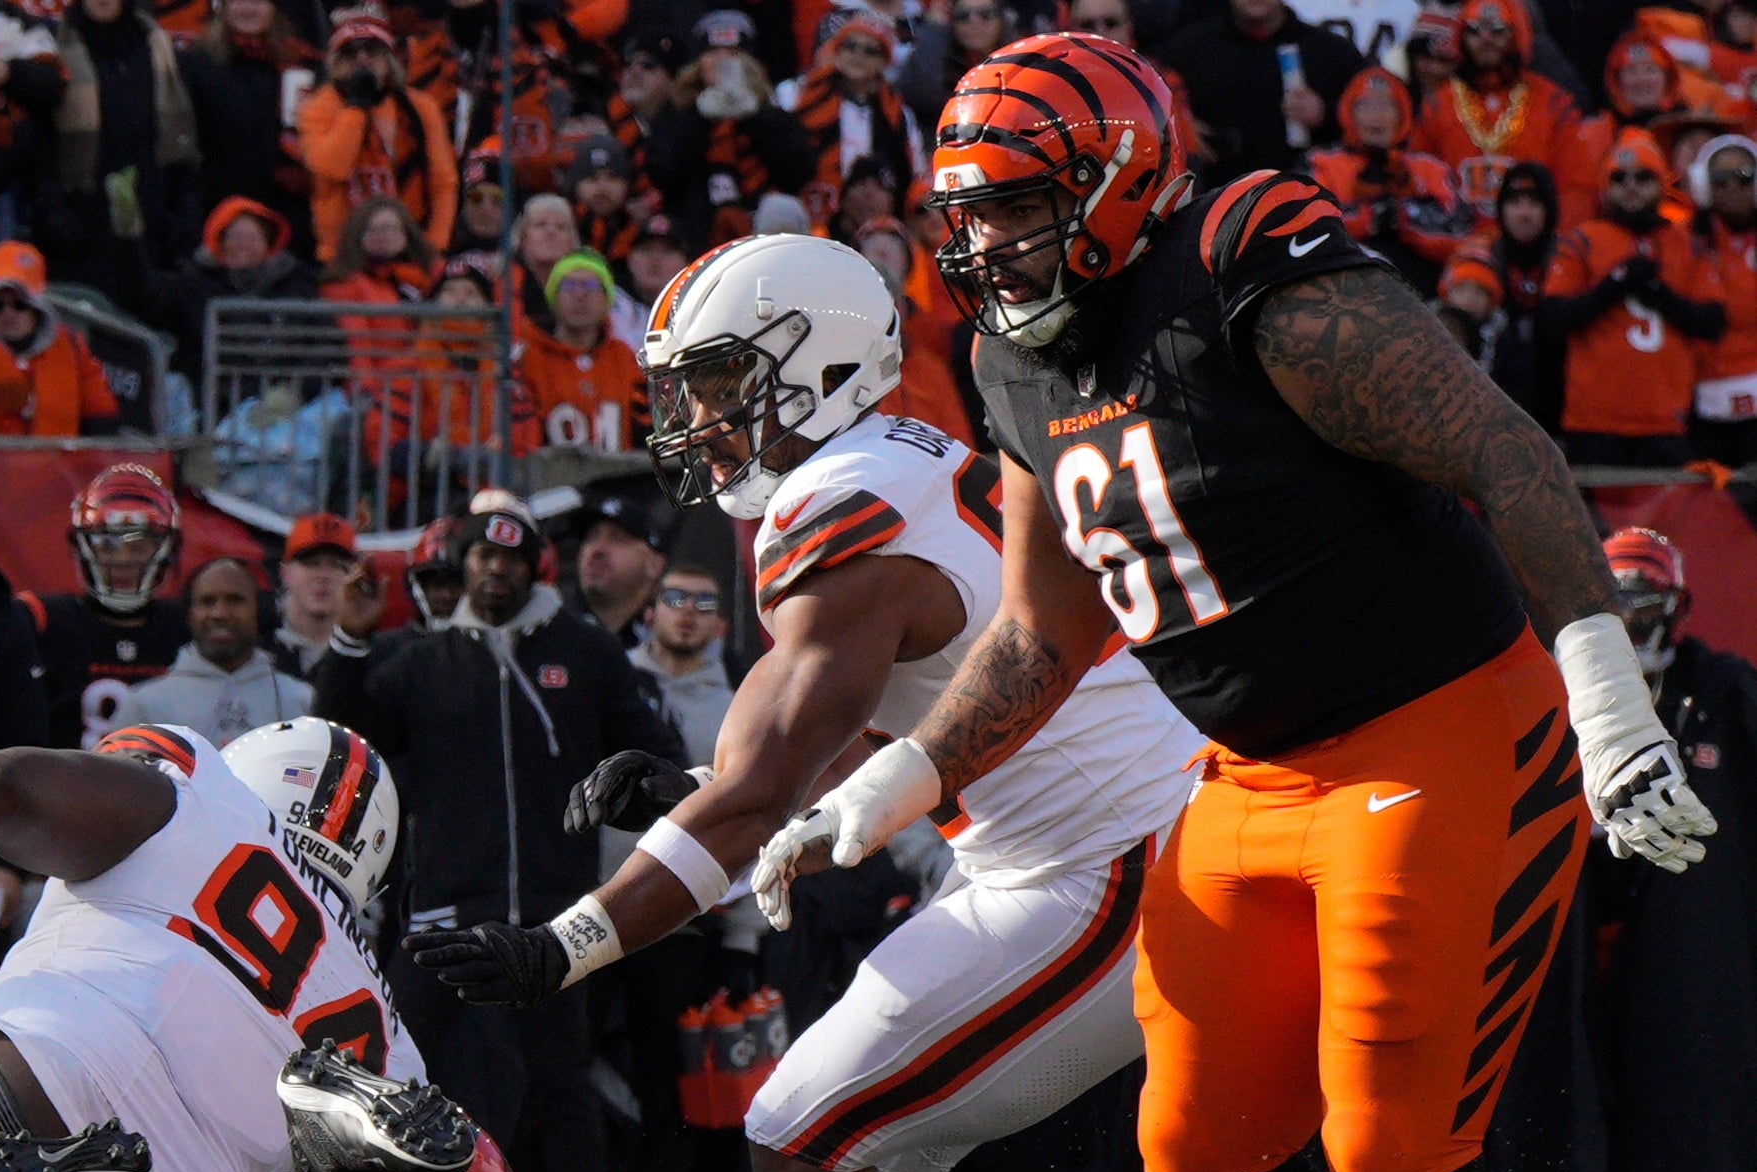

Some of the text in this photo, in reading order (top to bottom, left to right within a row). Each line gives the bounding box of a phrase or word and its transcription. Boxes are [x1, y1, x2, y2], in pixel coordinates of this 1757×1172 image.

[1048, 393, 1137, 437] BENGALS
[1052, 420, 1229, 643] 61
[283, 828, 354, 879] CLEVELAND
[286, 800, 367, 862] 9 4
